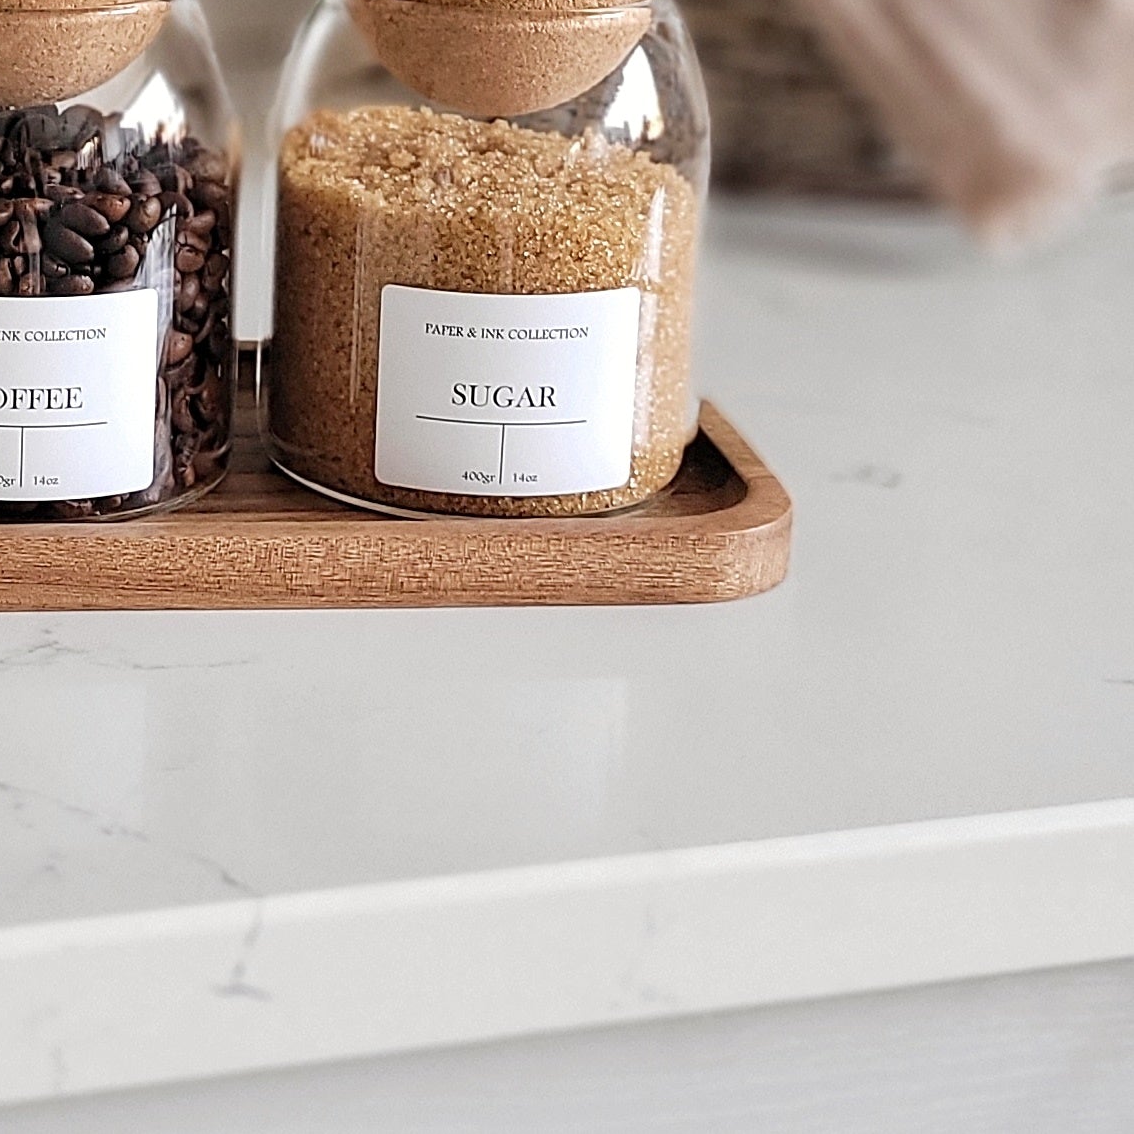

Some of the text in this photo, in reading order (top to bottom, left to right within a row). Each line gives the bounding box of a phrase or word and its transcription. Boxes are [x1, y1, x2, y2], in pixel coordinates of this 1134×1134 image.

[24, 328, 107, 342] COLLECTION
[425, 323, 589, 340] PAPER & INK COLLECTION
[451, 383, 557, 408] SUGAR
[33, 475, 59, 486] 14oz
[461, 471, 538, 484] 400gr 14oz
